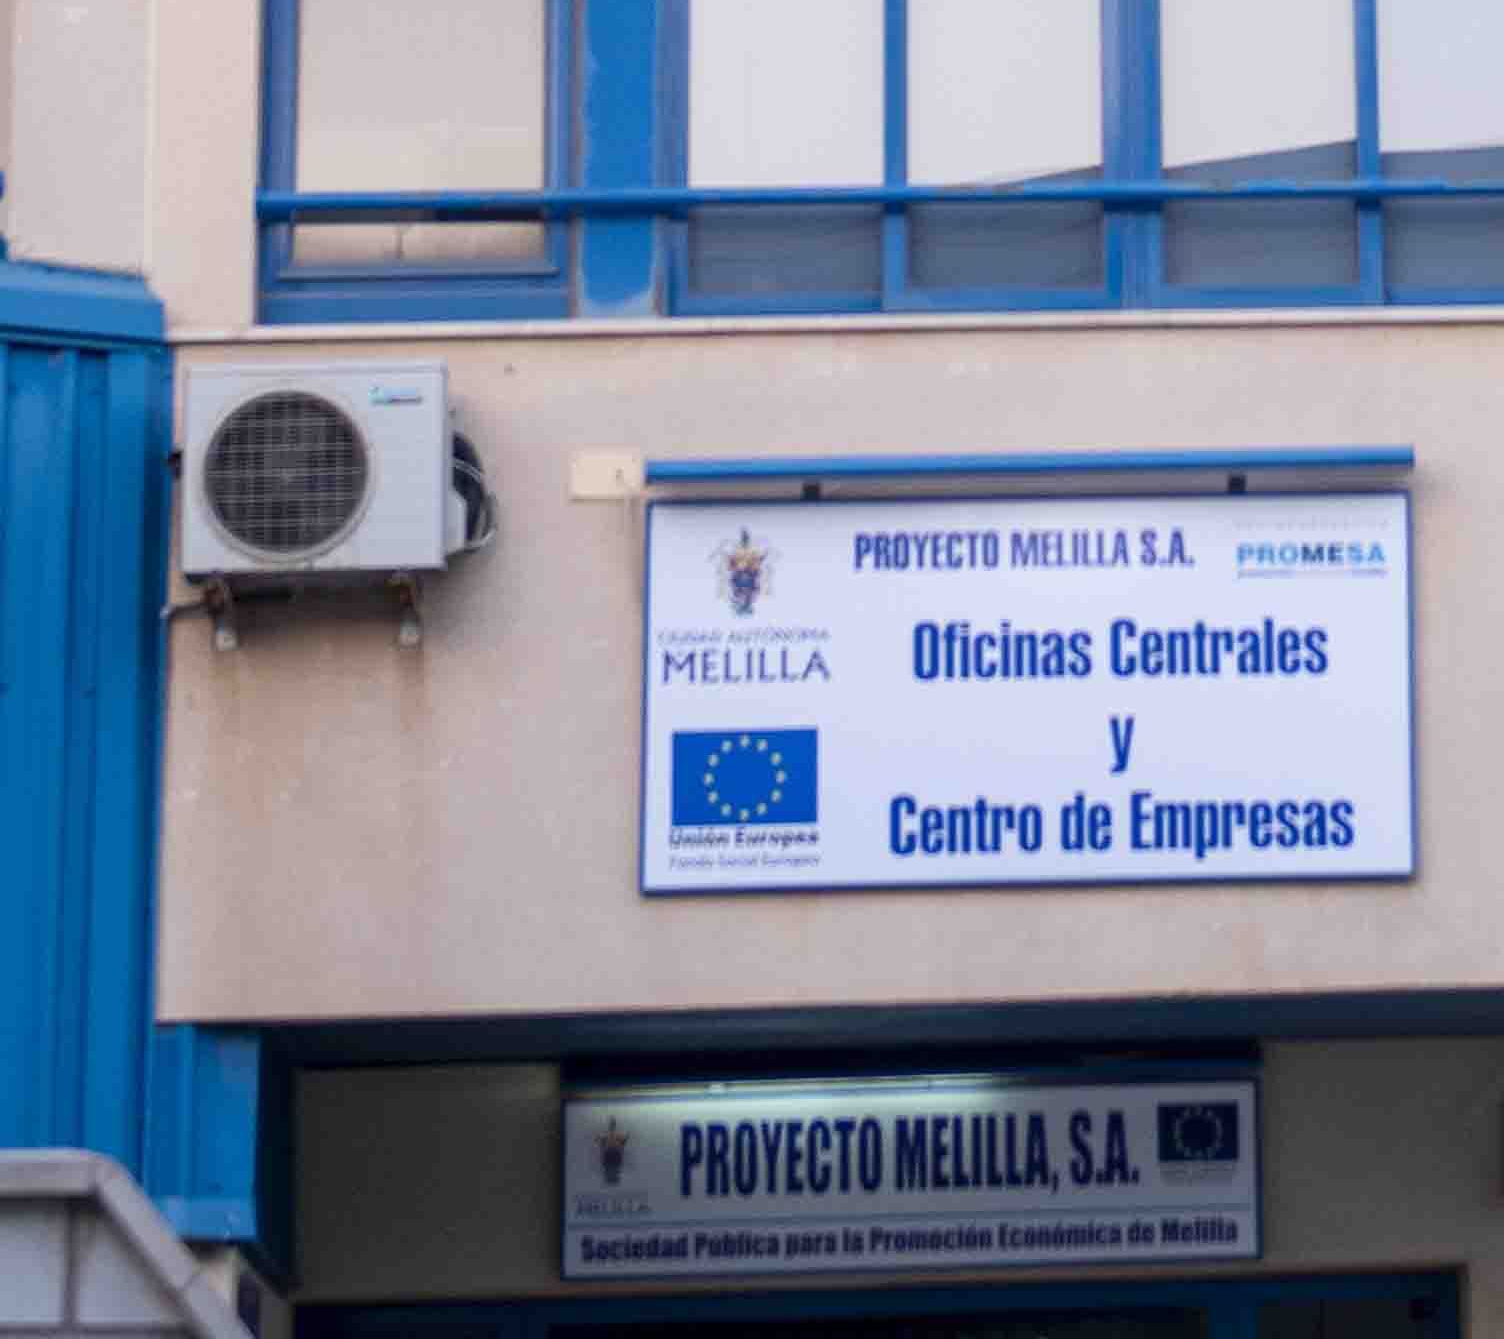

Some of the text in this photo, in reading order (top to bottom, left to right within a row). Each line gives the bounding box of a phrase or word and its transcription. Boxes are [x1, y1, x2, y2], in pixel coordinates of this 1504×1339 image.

[854, 525, 1196, 570] PROYECTO MELILLA S.A.
[1237, 539, 1386, 565] PROMESA
[661, 647, 832, 684] MELILLA
[912, 617, 1329, 681] Oficinas Centrales
[1108, 716, 1135, 774] y
[889, 789, 1356, 861] Centro de Empresas
[679, 1108, 1141, 1198] PROYECTO MELILLA, S.A.
[580, 1232, 689, 1264] Sociedad
[786, 1231, 837, 1258] para
[842, 1226, 866, 1254] la
[869, 1222, 993, 1253] Promoción
[999, 1219, 1124, 1251] Económica
[1127, 1219, 1155, 1244] de
[1160, 1216, 1239, 1244] Melilla
